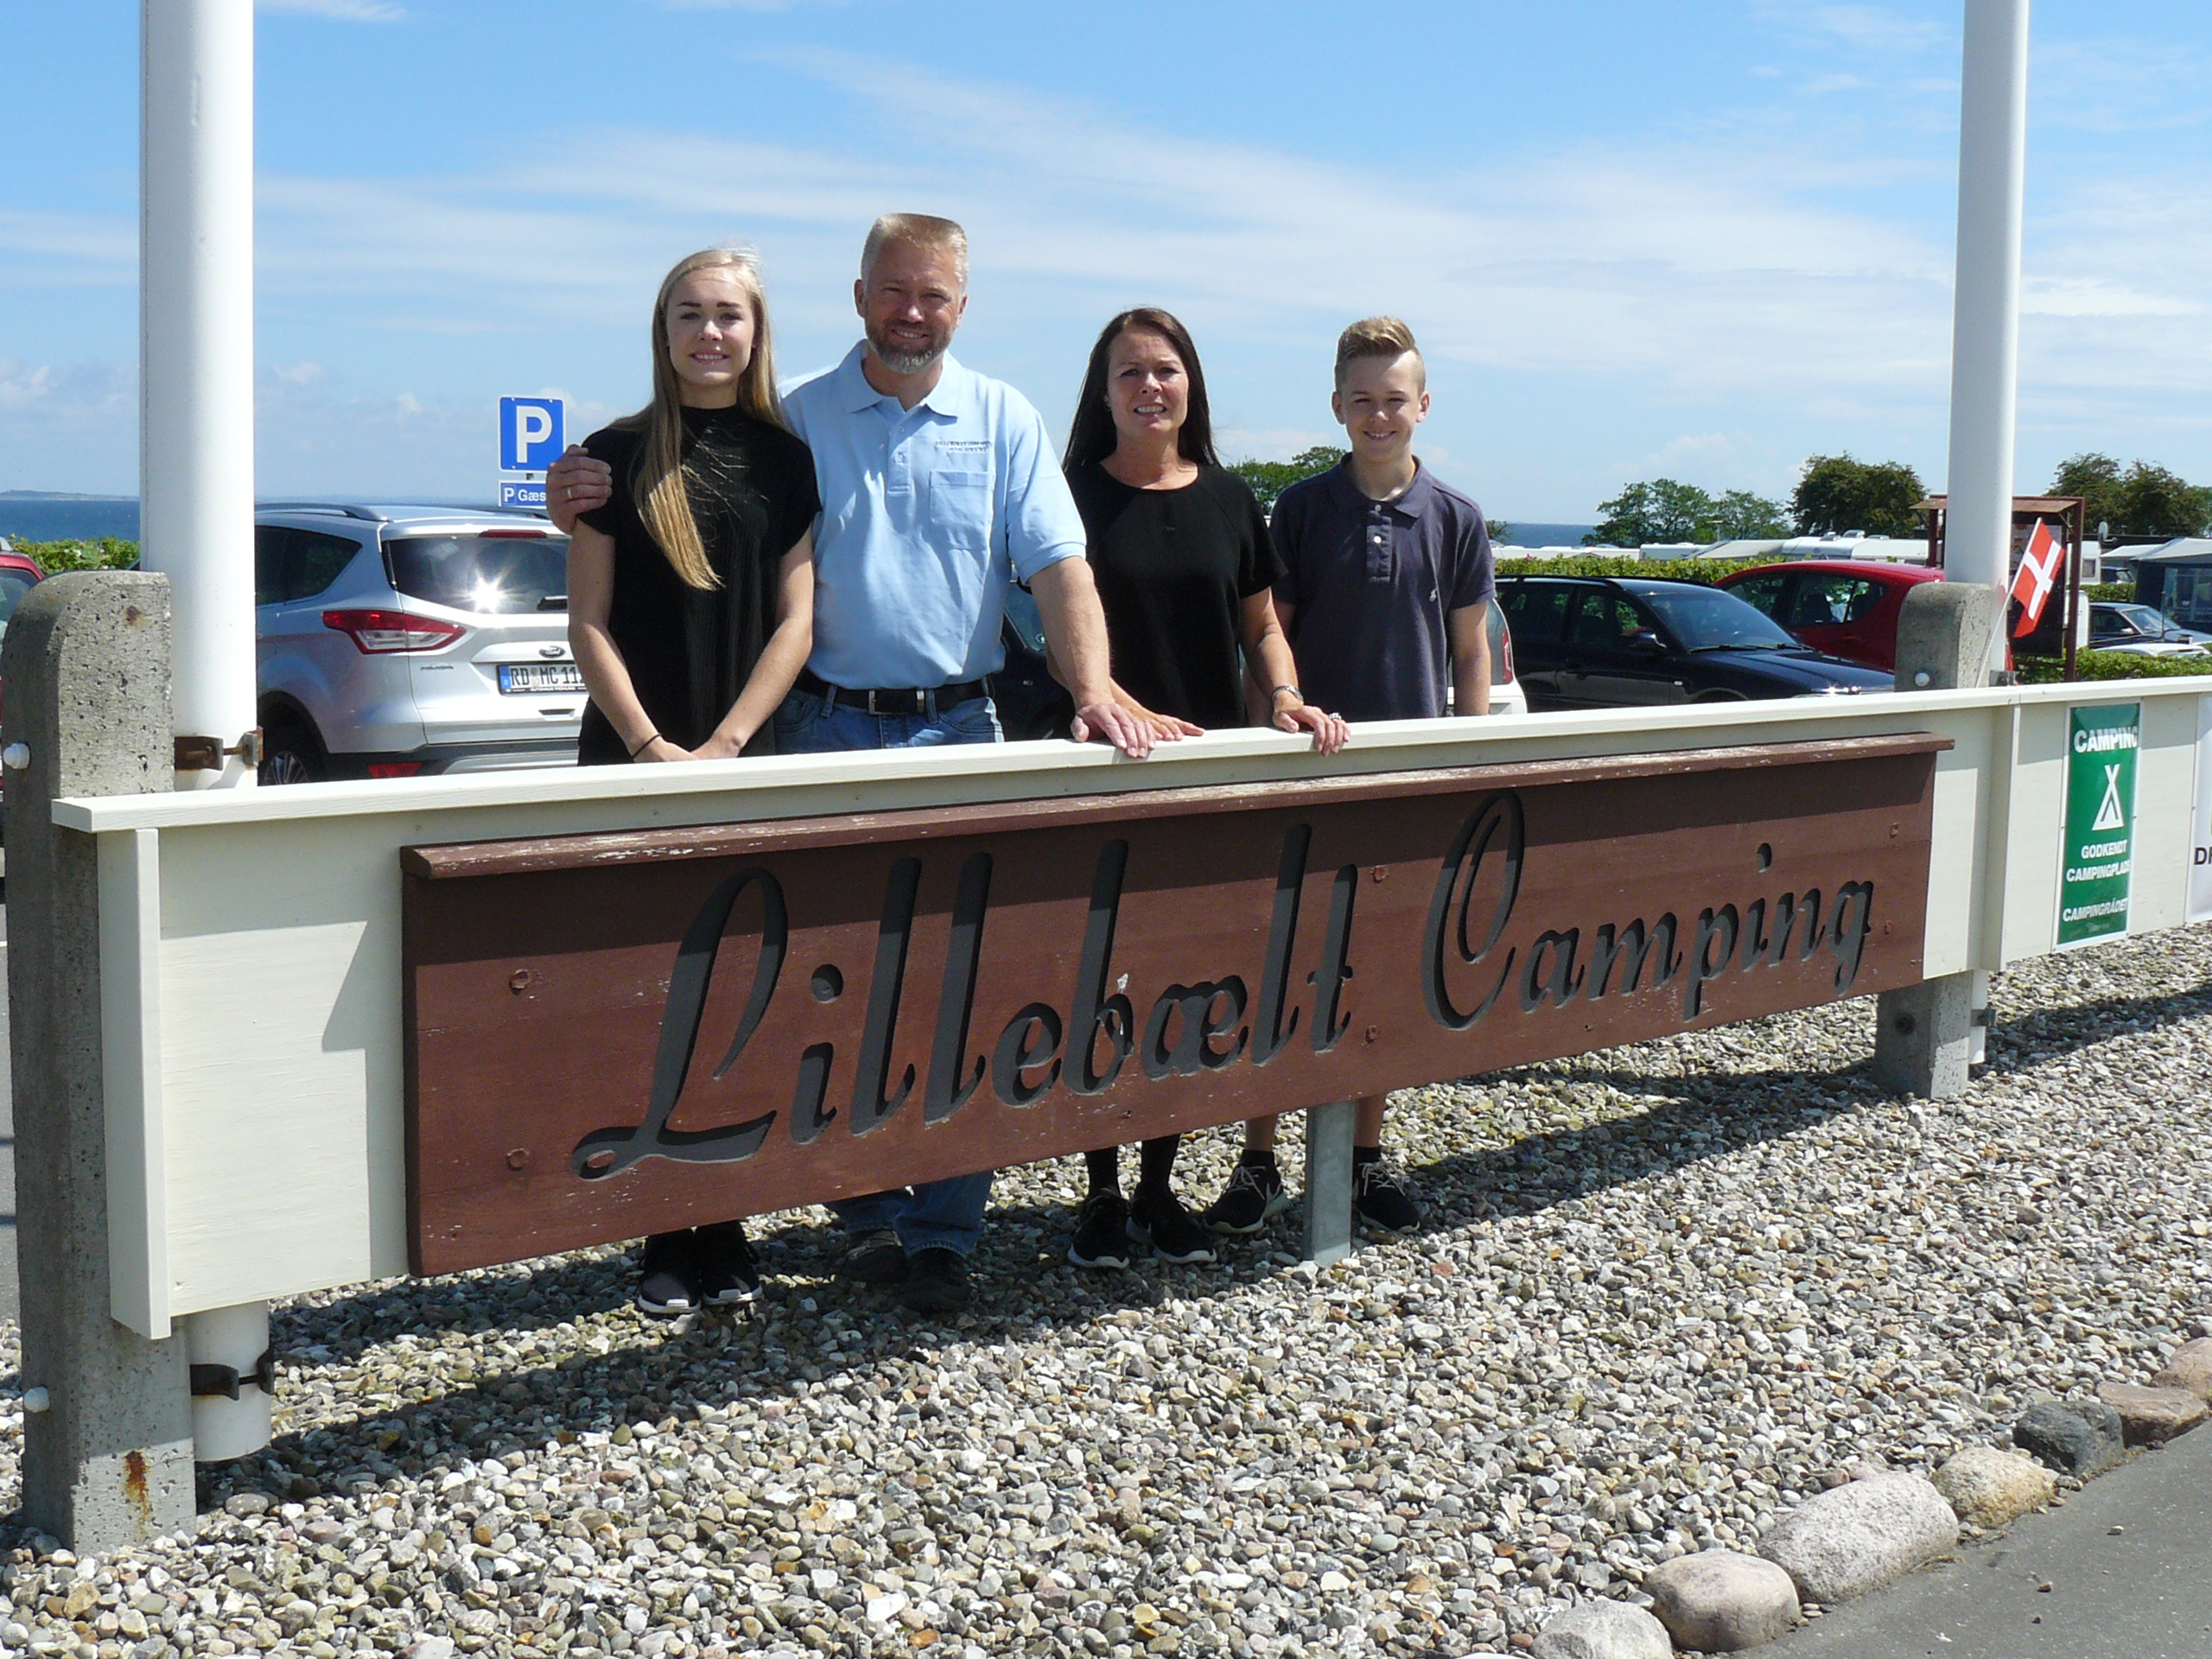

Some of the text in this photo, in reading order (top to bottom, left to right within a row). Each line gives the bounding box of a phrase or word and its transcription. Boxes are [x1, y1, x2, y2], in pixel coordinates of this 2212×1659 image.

[516, 405, 552, 463] P
[511, 667, 530, 685] RD
[561, 666, 584, 684] 11
[2074, 726, 2138, 753] CAMPING
[2081, 839, 2127, 859] GODKENDT
[2066, 860, 2131, 882] CAMPINGPLADS
[2063, 897, 2128, 922] CAMPINGRÅDET
[570, 790, 1874, 1180] Lillebælt Camping
